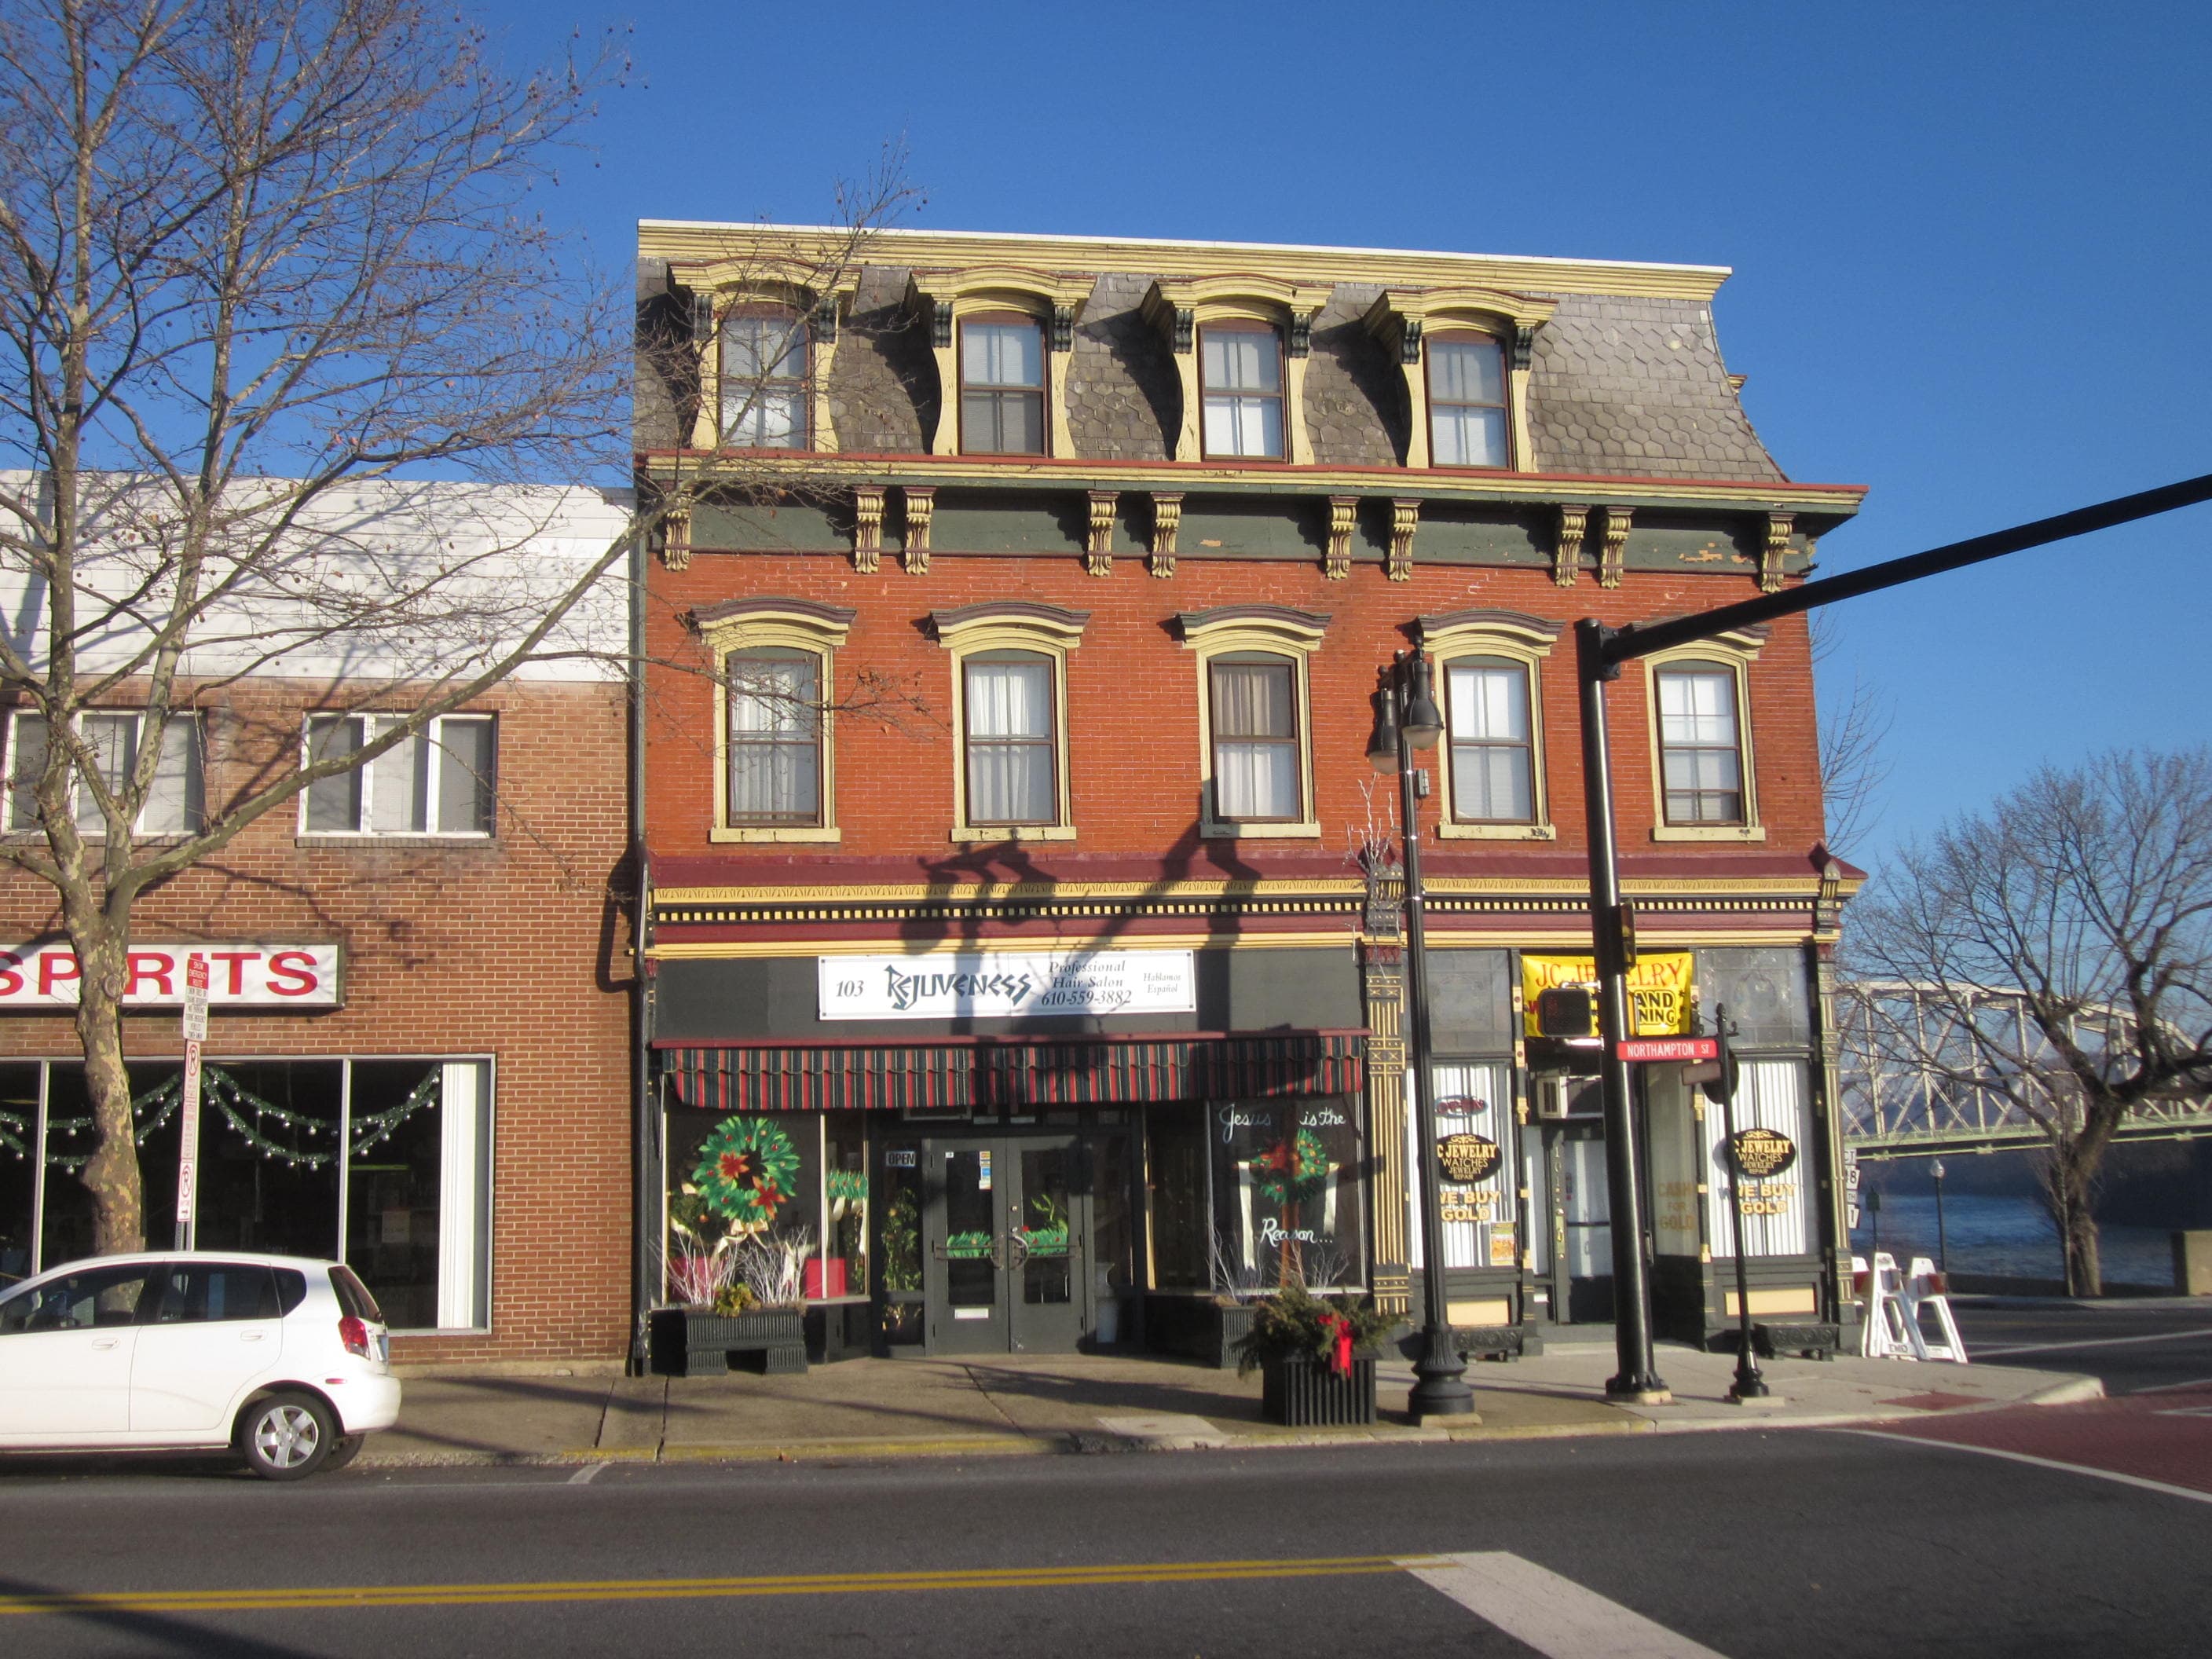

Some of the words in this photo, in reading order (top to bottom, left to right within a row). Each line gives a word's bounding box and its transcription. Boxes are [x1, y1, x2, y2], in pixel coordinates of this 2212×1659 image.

[0, 951, 319, 997] PRTS
[1049, 961, 1126, 976] Professional
[1536, 964, 1562, 987] JC
[1053, 976, 1083, 989] Hair
[1087, 976, 1123, 988] Salon
[1143, 972, 1181, 983] Hablamos
[836, 980, 864, 998] 103
[1147, 983, 1178, 996] Español
[1042, 990, 1133, 1006] 610-559-3882
[1627, 1042, 1695, 1057] NORTHAMPTON
[1701, 1044, 1710, 1055] ST
[1219, 1104, 1271, 1144] Jesus
[1299, 1111, 1317, 1126] is
[1445, 1144, 1496, 1159] JEWELRY
[1741, 1140, 1791, 1154] JEWELRY
[888, 1153, 914, 1165] OPEN
[1442, 1158, 1489, 1168] WATCHES
[1738, 1152, 1783, 1163] WATCHES
[1448, 1166, 1482, 1175] JEWELRY
[1464, 1190, 1501, 1204] BUY
[1760, 1184, 1797, 1198] BUY
[1441, 1207, 1490, 1222] GOLD
[1741, 1201, 1788, 1215] GOLD
